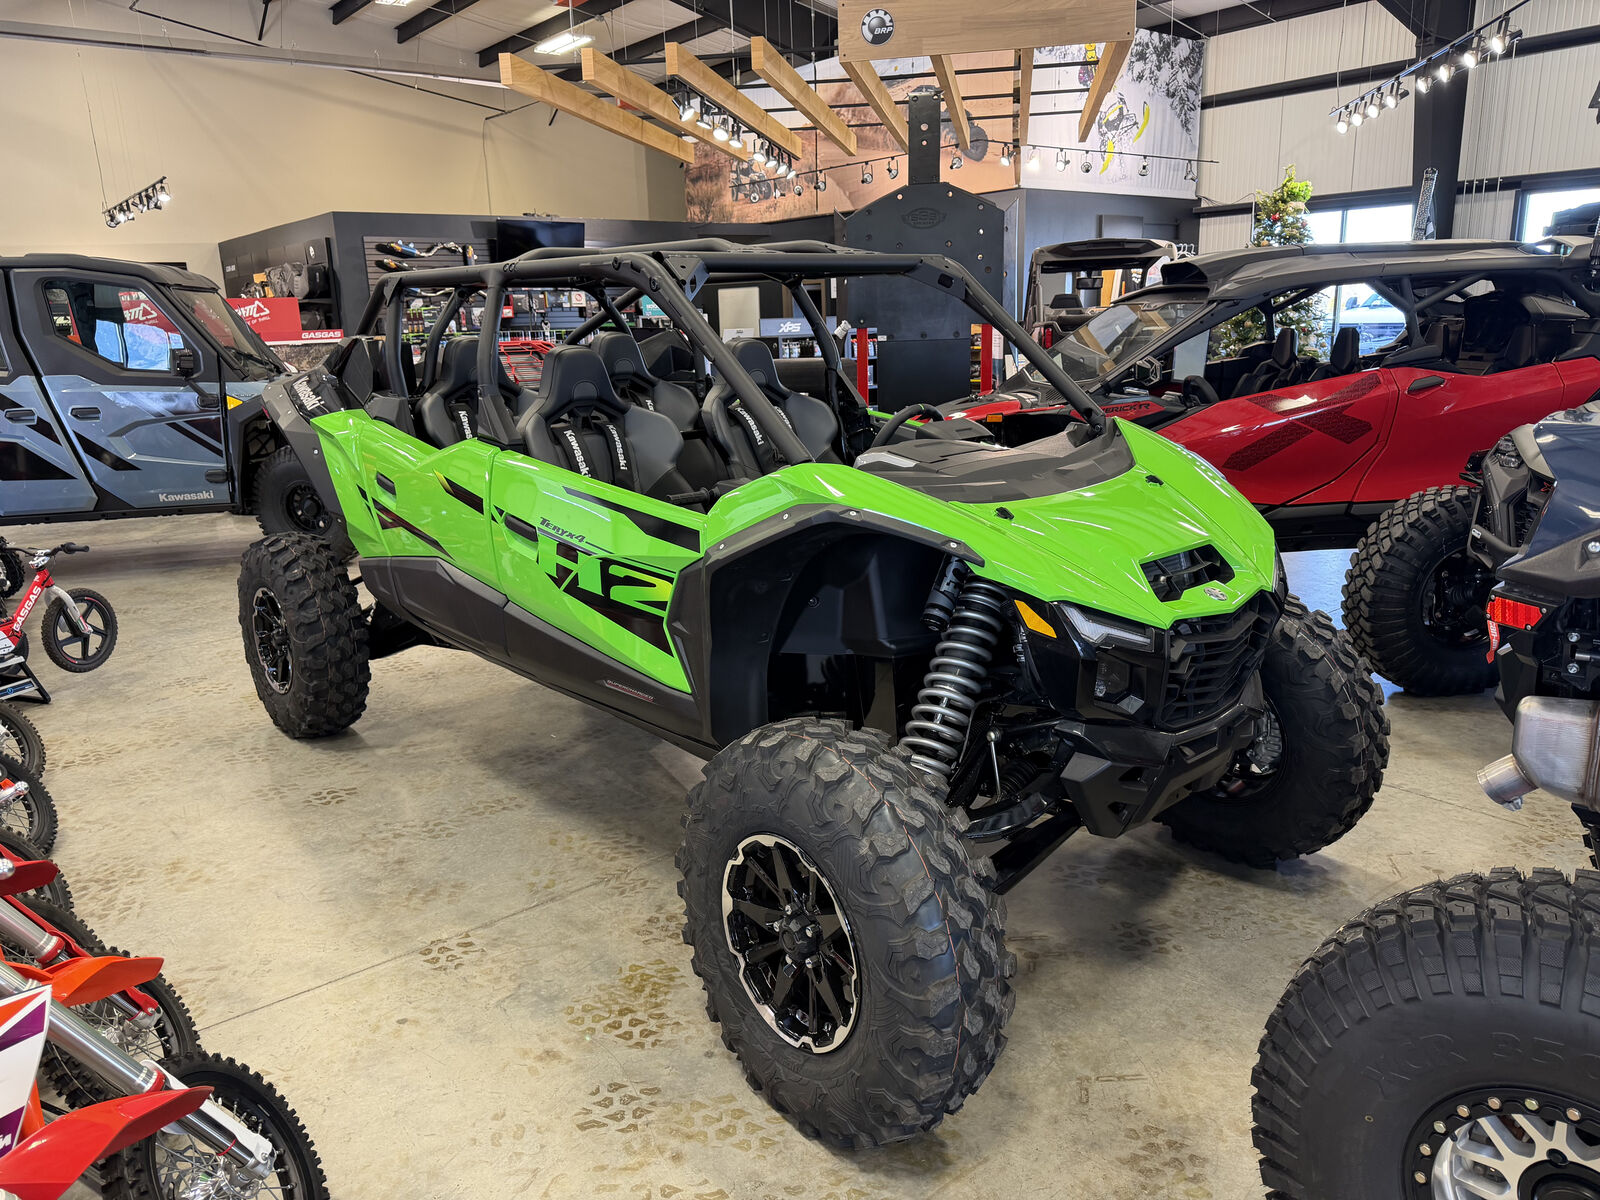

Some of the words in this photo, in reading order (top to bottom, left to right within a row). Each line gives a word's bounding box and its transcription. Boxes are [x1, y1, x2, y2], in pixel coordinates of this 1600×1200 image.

[874, 26, 893, 35] BRP
[301, 331, 341, 339] GASGAS
[778, 321, 802, 333] XPS
[293, 375, 325, 410] Kawasaki
[458, 410, 473, 440] Kawas
[736, 407, 764, 446] Kawasaki
[606, 424, 628, 471] Kawasaki
[158, 490, 214, 502] Kawasaki
[13, 586, 42, 631] GASGAS
